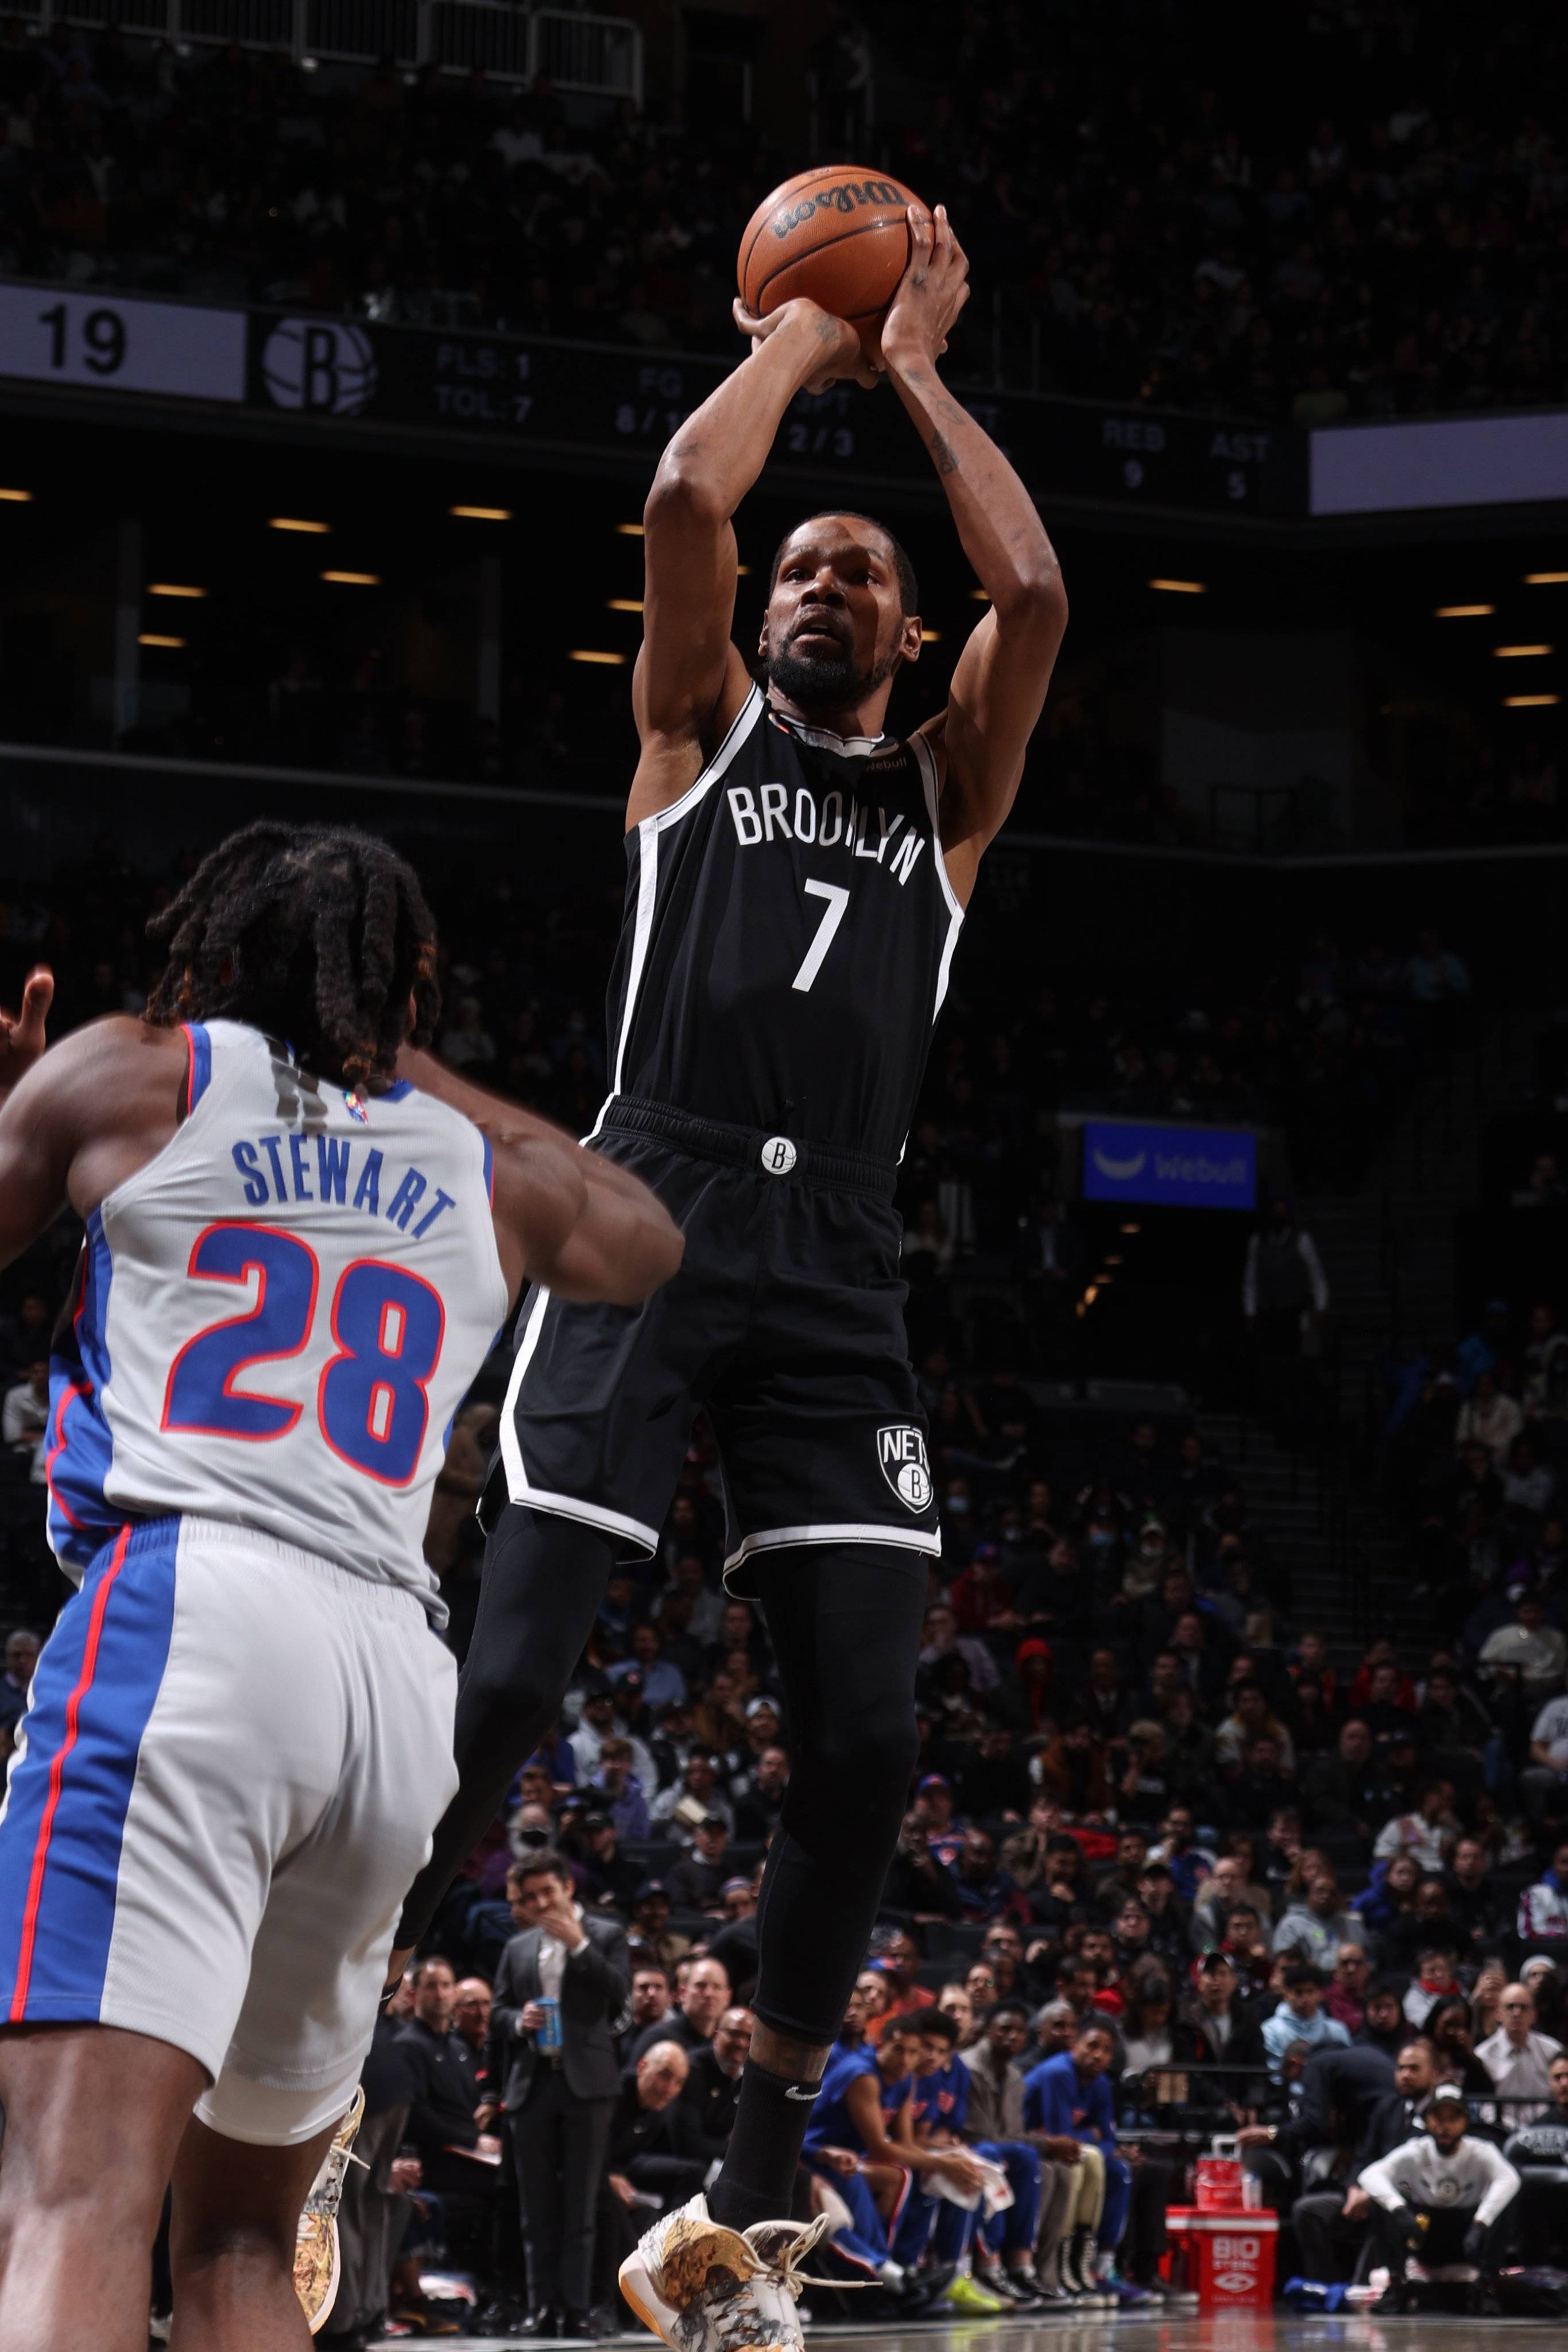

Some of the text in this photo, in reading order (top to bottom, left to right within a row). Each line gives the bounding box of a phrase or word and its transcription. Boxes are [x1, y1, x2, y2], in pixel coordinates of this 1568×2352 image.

[771, 181, 909, 239] Wilson
[38, 304, 125, 374] 19
[306, 326, 337, 406] B
[516, 352, 532, 379] 1
[638, 366, 682, 397] FG
[513, 394, 533, 423] 7
[1102, 417, 1166, 452] REB
[1209, 431, 1269, 464] AST
[791, 877, 850, 993] 7
[772, 1142, 786, 1169] B
[232, 1133, 456, 1239] STEWART
[161, 1220, 446, 1488] 28
[883, 1429, 928, 1468] NET
[1211, 2235, 1260, 2260] BIO
